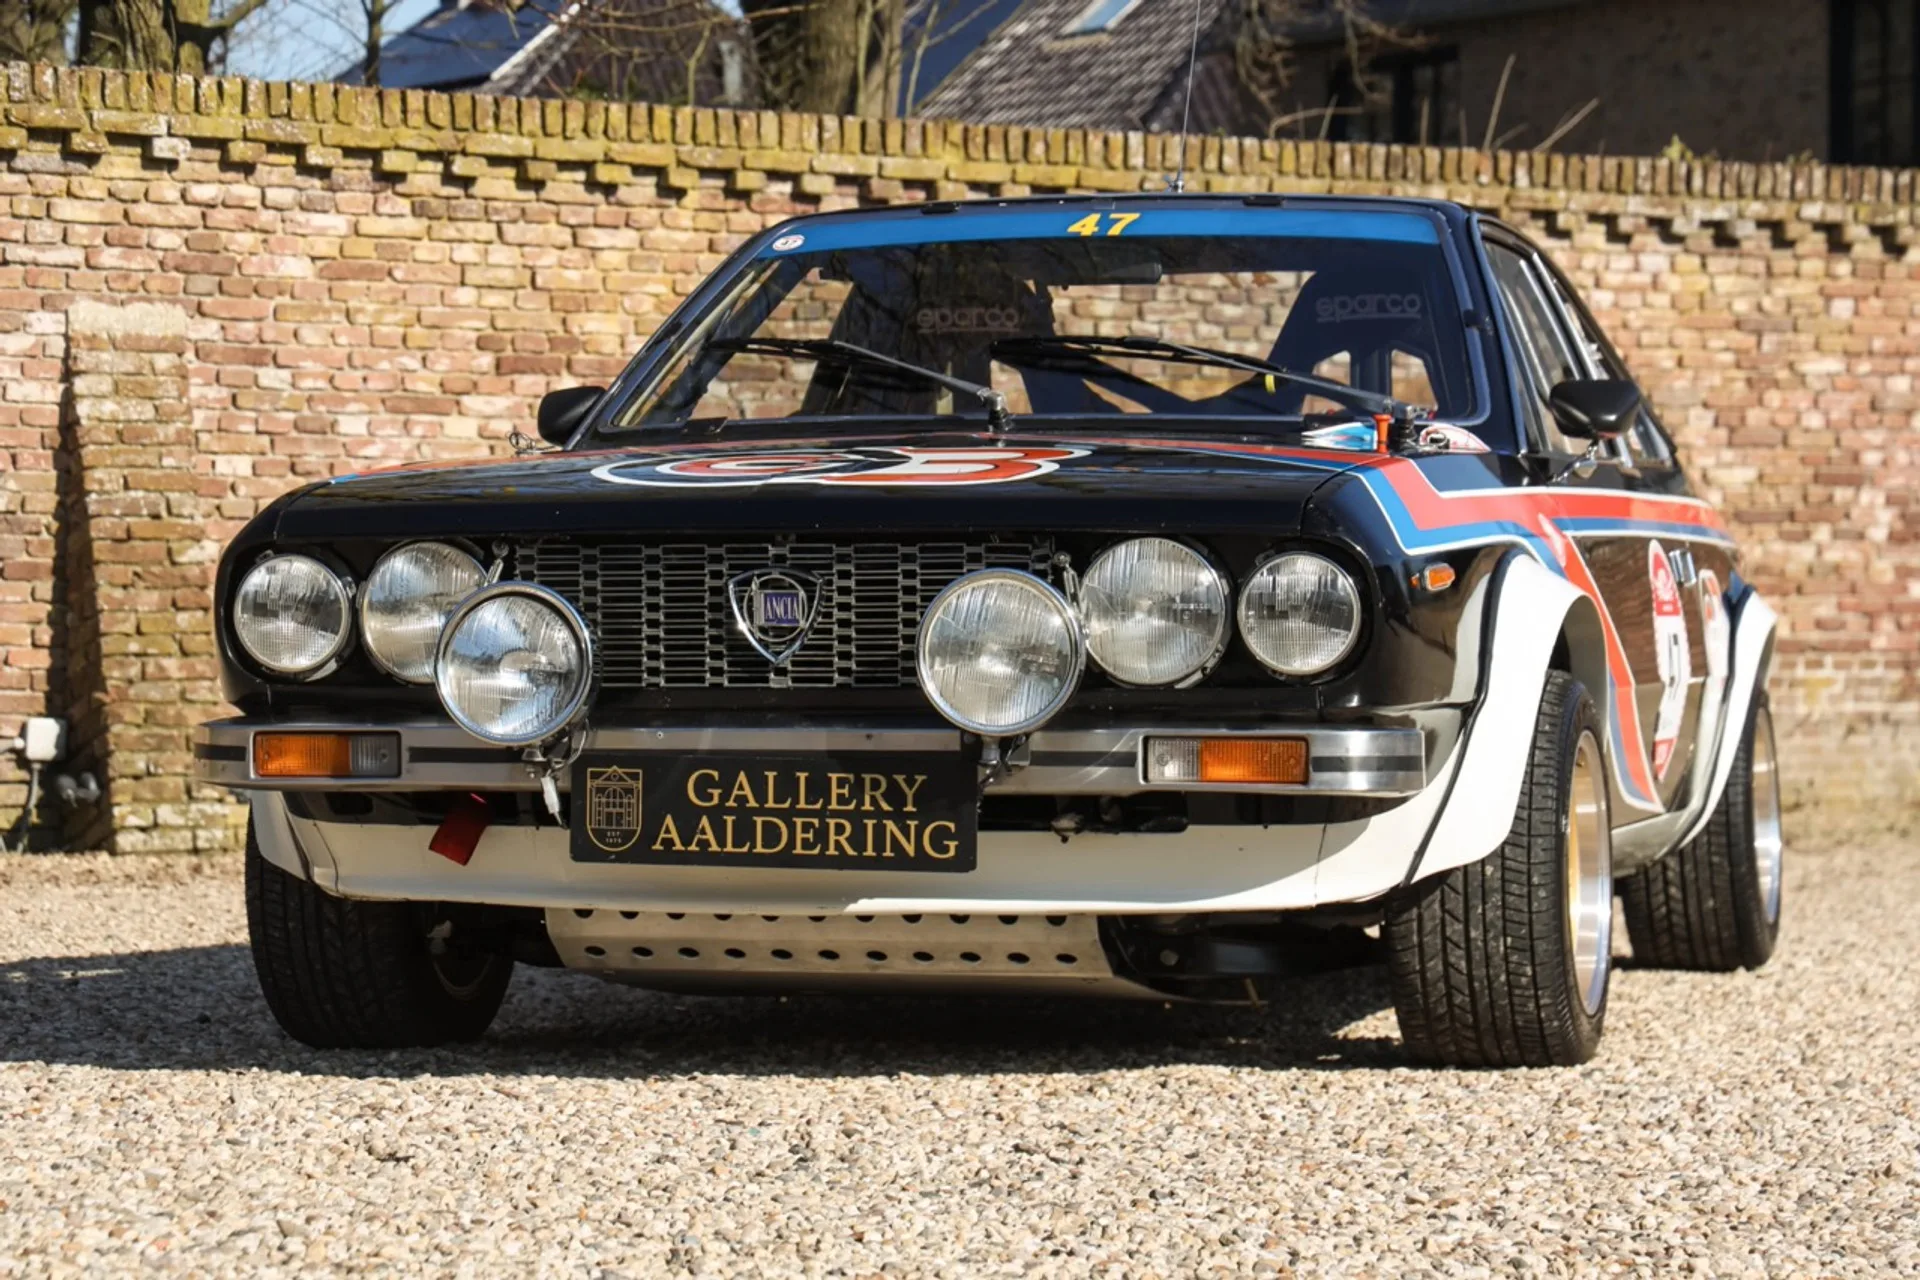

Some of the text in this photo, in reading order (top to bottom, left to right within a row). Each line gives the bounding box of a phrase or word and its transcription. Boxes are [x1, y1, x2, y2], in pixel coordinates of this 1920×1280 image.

[1066, 212, 1141, 236] 47
[1316, 293, 1421, 323] sparco
[760, 593, 799, 624] LANCIA
[687, 769, 927, 812] GALLERY
[652, 813, 959, 859] AALDERING
